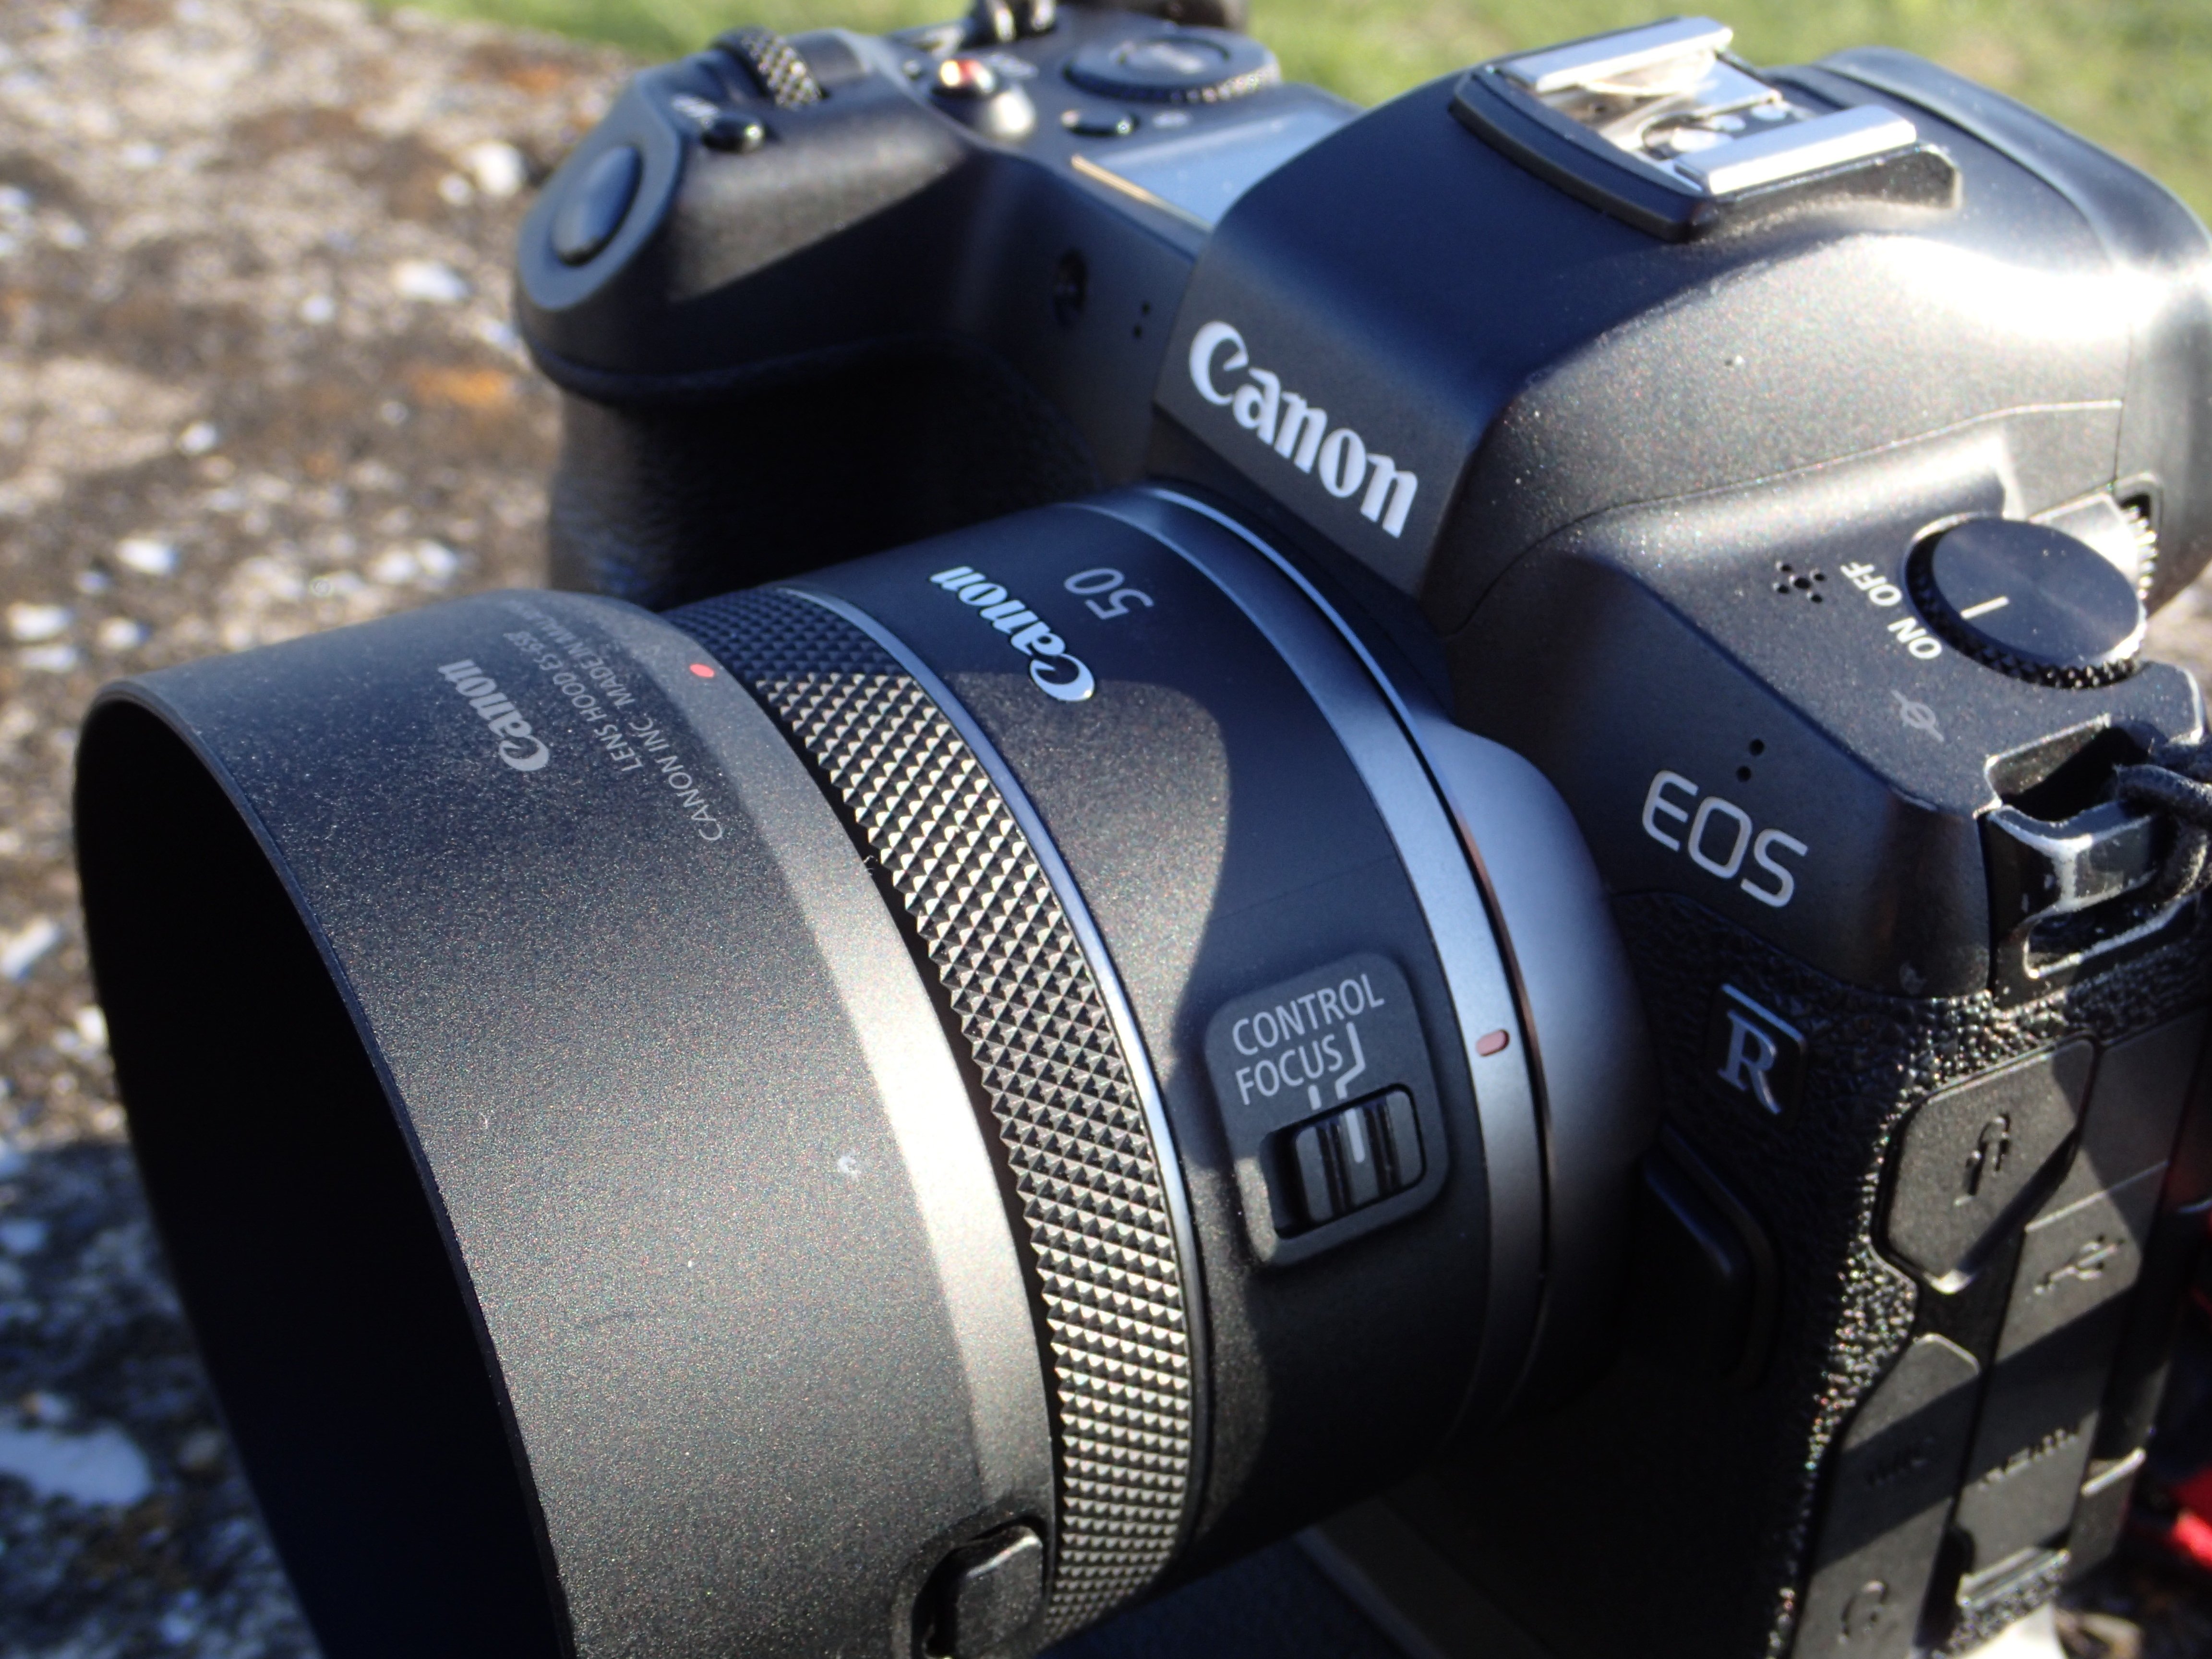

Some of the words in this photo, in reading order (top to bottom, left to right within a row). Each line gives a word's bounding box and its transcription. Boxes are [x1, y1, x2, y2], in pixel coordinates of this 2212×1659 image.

[1189, 320, 1419, 538] Canon
[1064, 567, 1153, 620] 50
[1839, 562, 1902, 607] OFF
[929, 565, 1095, 702] Canon
[1887, 616, 1943, 660] ON
[438, 659, 549, 771] Canon
[553, 672, 608, 723] HOOD
[579, 655, 636, 708] MADE
[593, 723, 643, 771] LENS
[655, 755, 722, 841] CANON
[1642, 769, 1808, 908] EOS
[1232, 974, 1385, 1056] CONTROL
[1235, 1034, 1344, 1106] FOCUS
[1717, 1009, 1781, 1115] R
